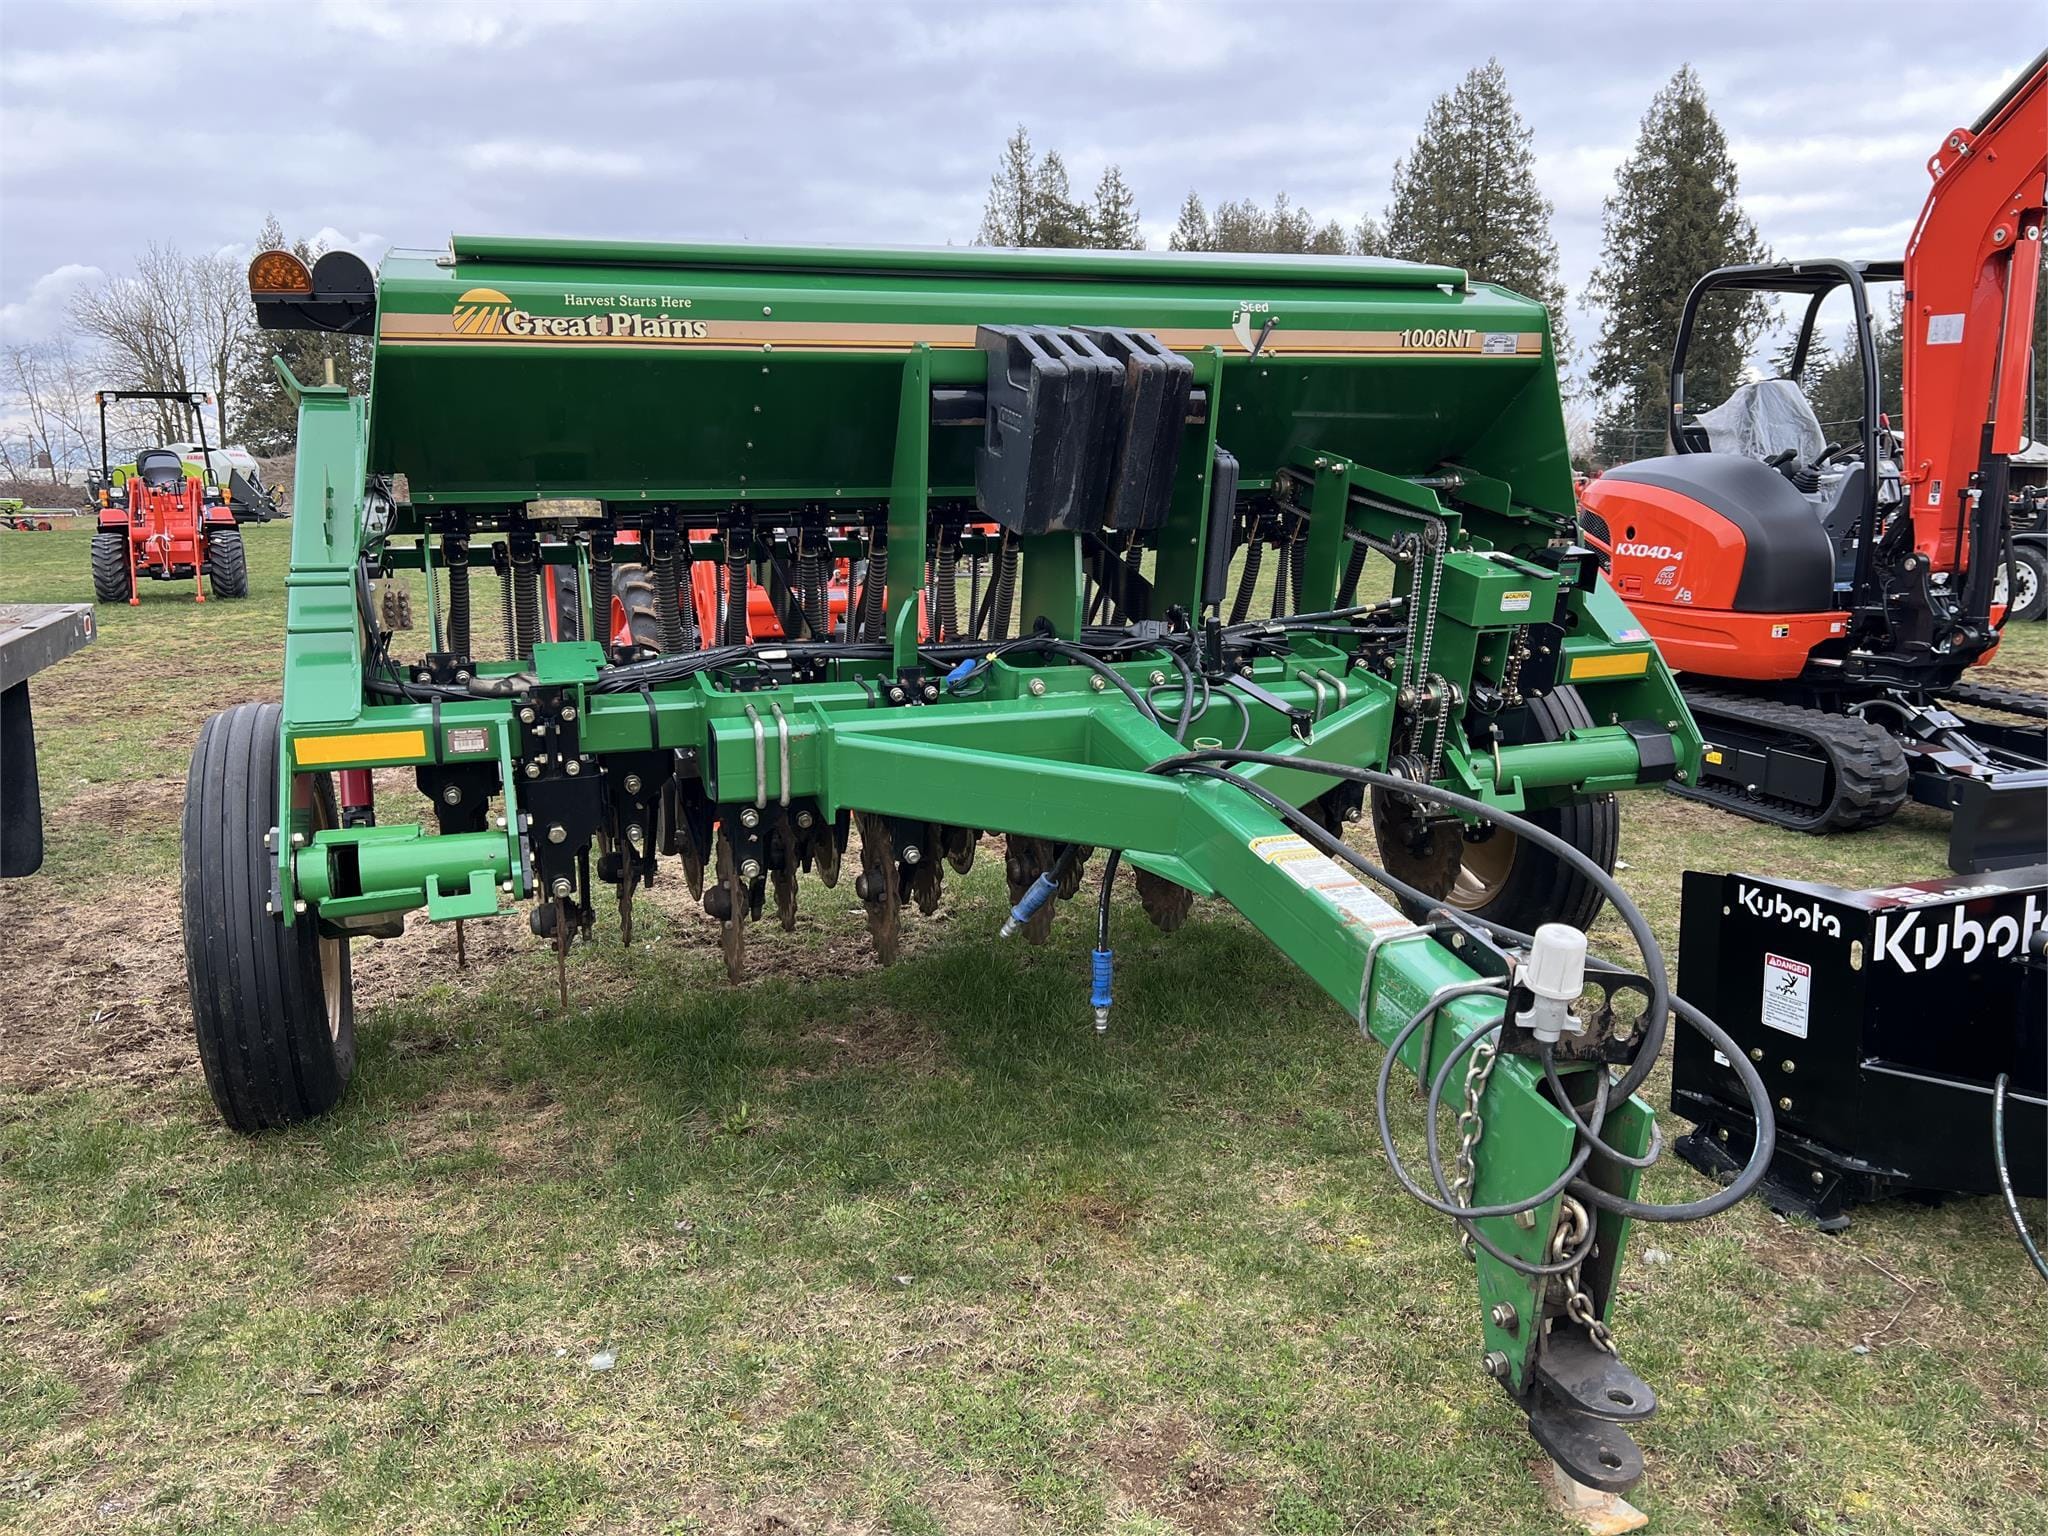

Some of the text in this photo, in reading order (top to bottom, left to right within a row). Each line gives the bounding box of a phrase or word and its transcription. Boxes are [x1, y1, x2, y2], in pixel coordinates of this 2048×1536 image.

[564, 293, 692, 308] Harvest Starts Here
[1240, 300, 1269, 313] Seed
[504, 310, 708, 339] Great Plains
[1232, 310, 1240, 323] F
[1400, 328, 1477, 348] 1006NT
[1615, 543, 1684, 561] KX040-4
[1738, 883, 1841, 938] Kubota
[1873, 894, 2048, 973] Kubot
[1775, 958, 1808, 976] DANGER
